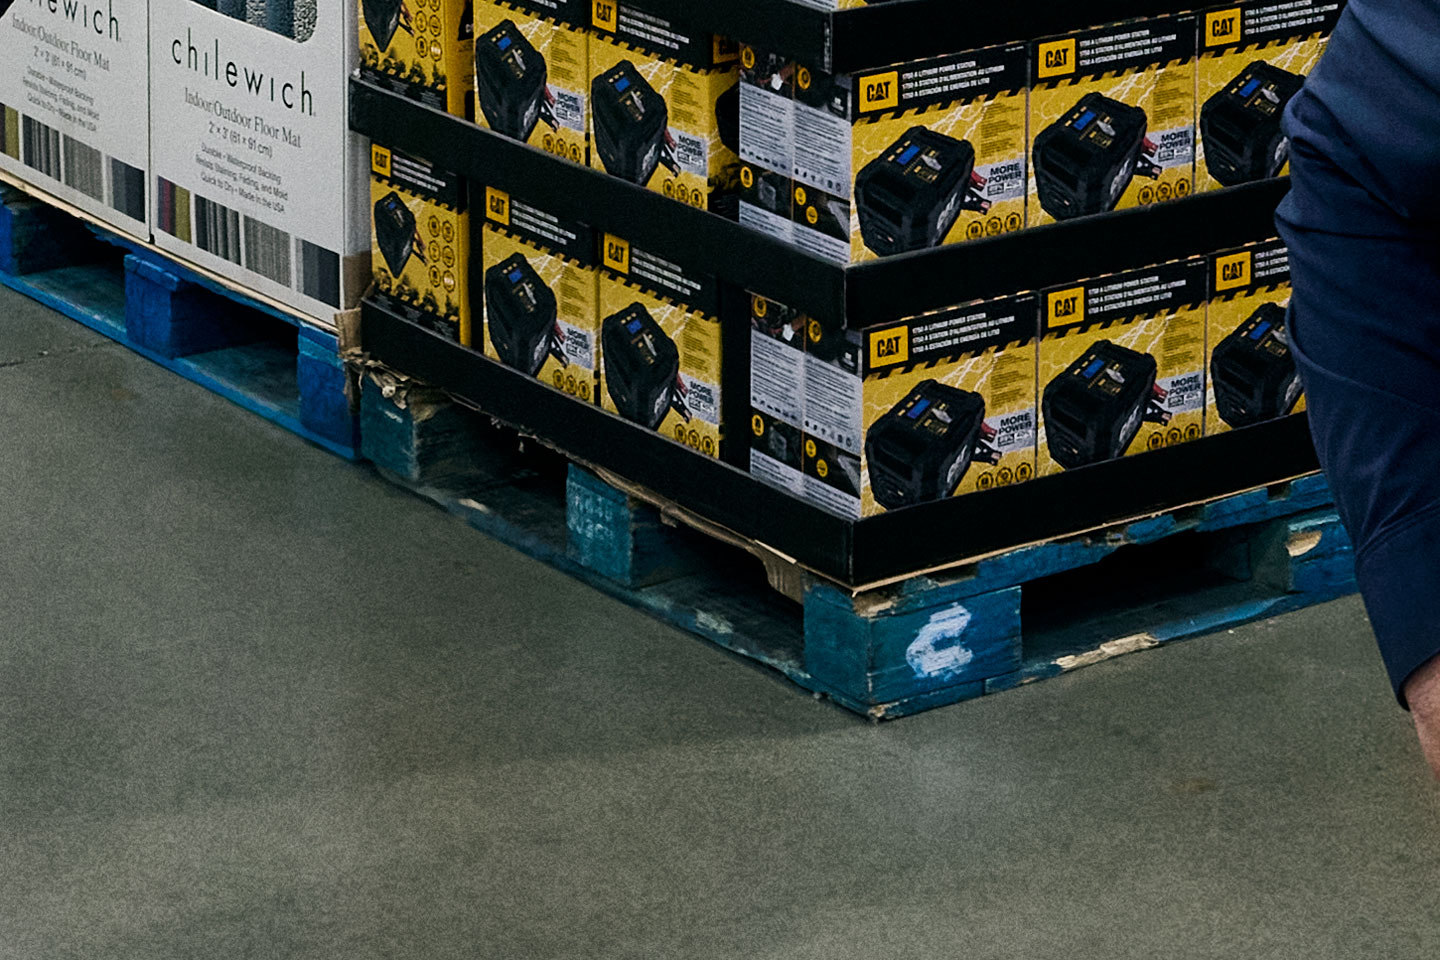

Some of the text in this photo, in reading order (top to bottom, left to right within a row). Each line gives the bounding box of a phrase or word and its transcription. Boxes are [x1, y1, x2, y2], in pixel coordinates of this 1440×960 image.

[1212, 17, 1235, 37] CAT
[1045, 48, 1069, 68] CAT
[172, 27, 313, 116] chilewich
[867, 81, 891, 102] CAT
[185, 87, 301, 148] Indoor/Outdoor Floor Mat
[608, 242, 625, 263] CAT
[1222, 261, 1245, 281] CAT
[1055, 296, 1078, 318] CAT
[877, 336, 901, 358] CAT
[998, 421, 1035, 436] POWER
[1000, 412, 1032, 426] MORE
